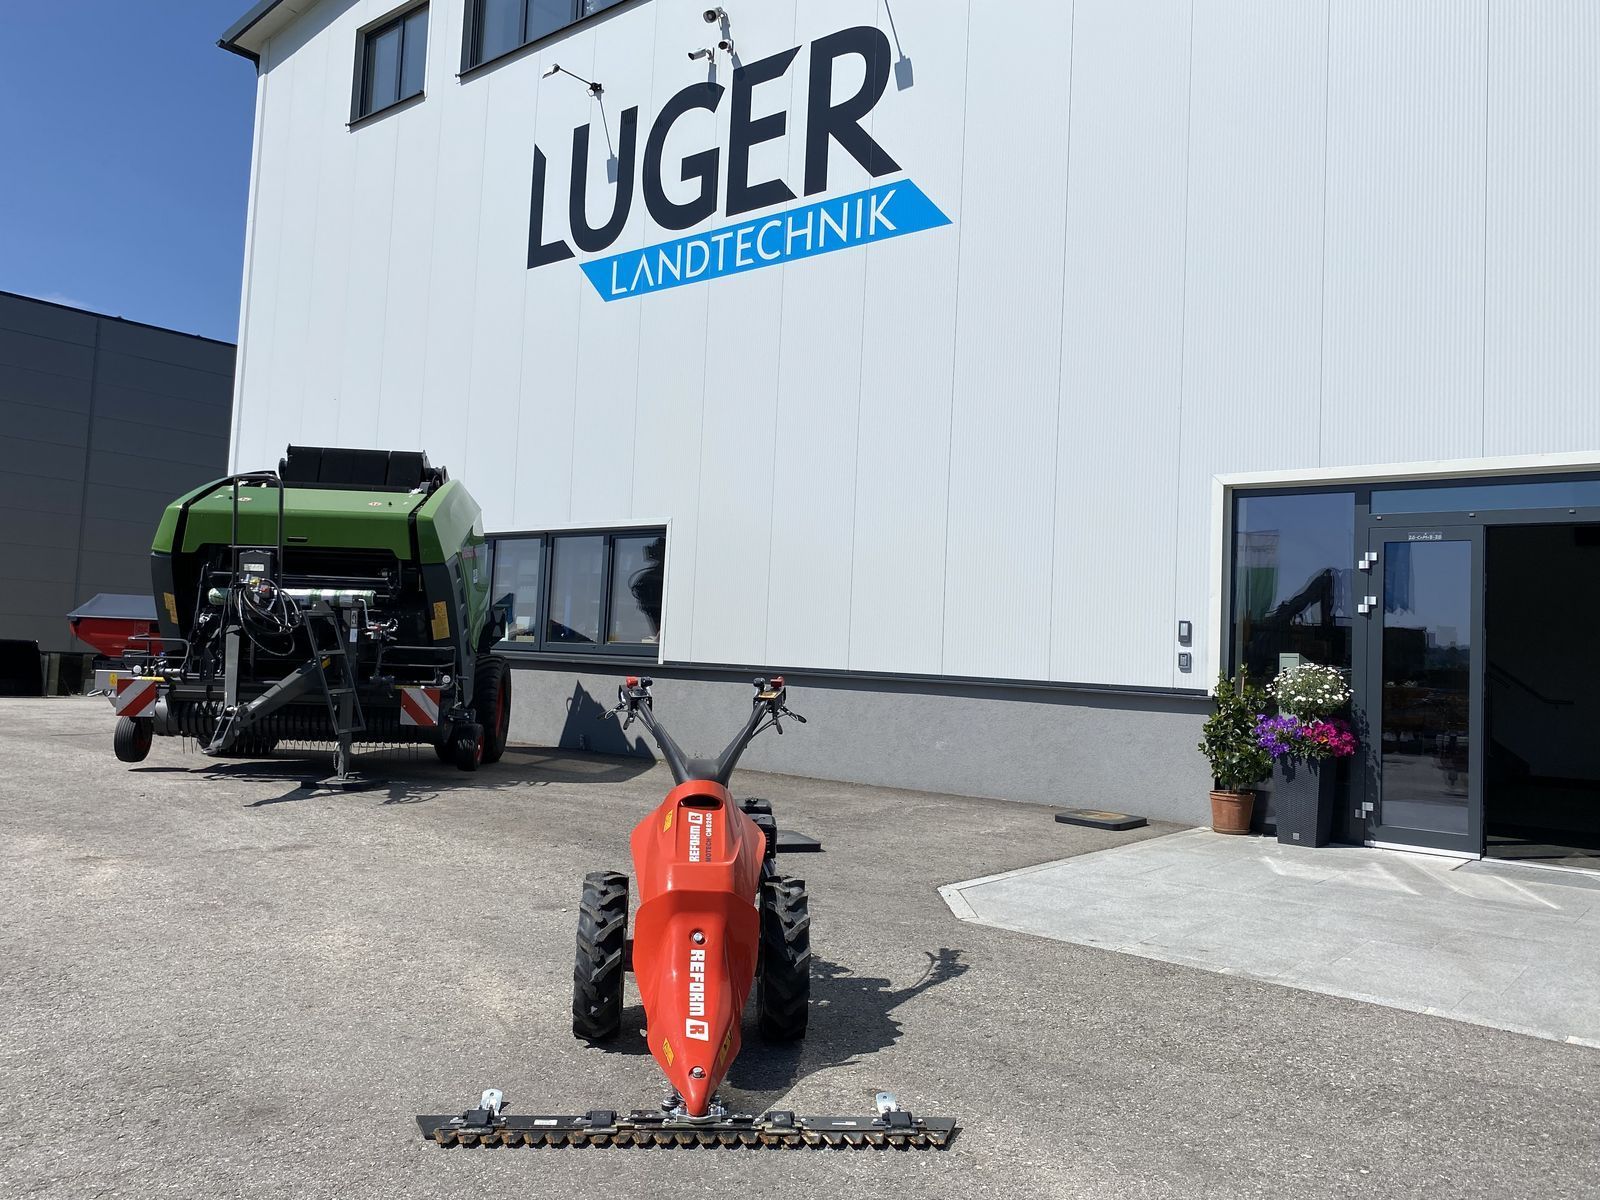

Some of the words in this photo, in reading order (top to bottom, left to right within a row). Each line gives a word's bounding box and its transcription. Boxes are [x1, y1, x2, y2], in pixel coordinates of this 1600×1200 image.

[527, 26, 903, 270] LUGER
[611, 189, 897, 296] LANDTECHNIK
[689, 825, 701, 862] REFORM
[689, 949, 706, 1017] REFORM
